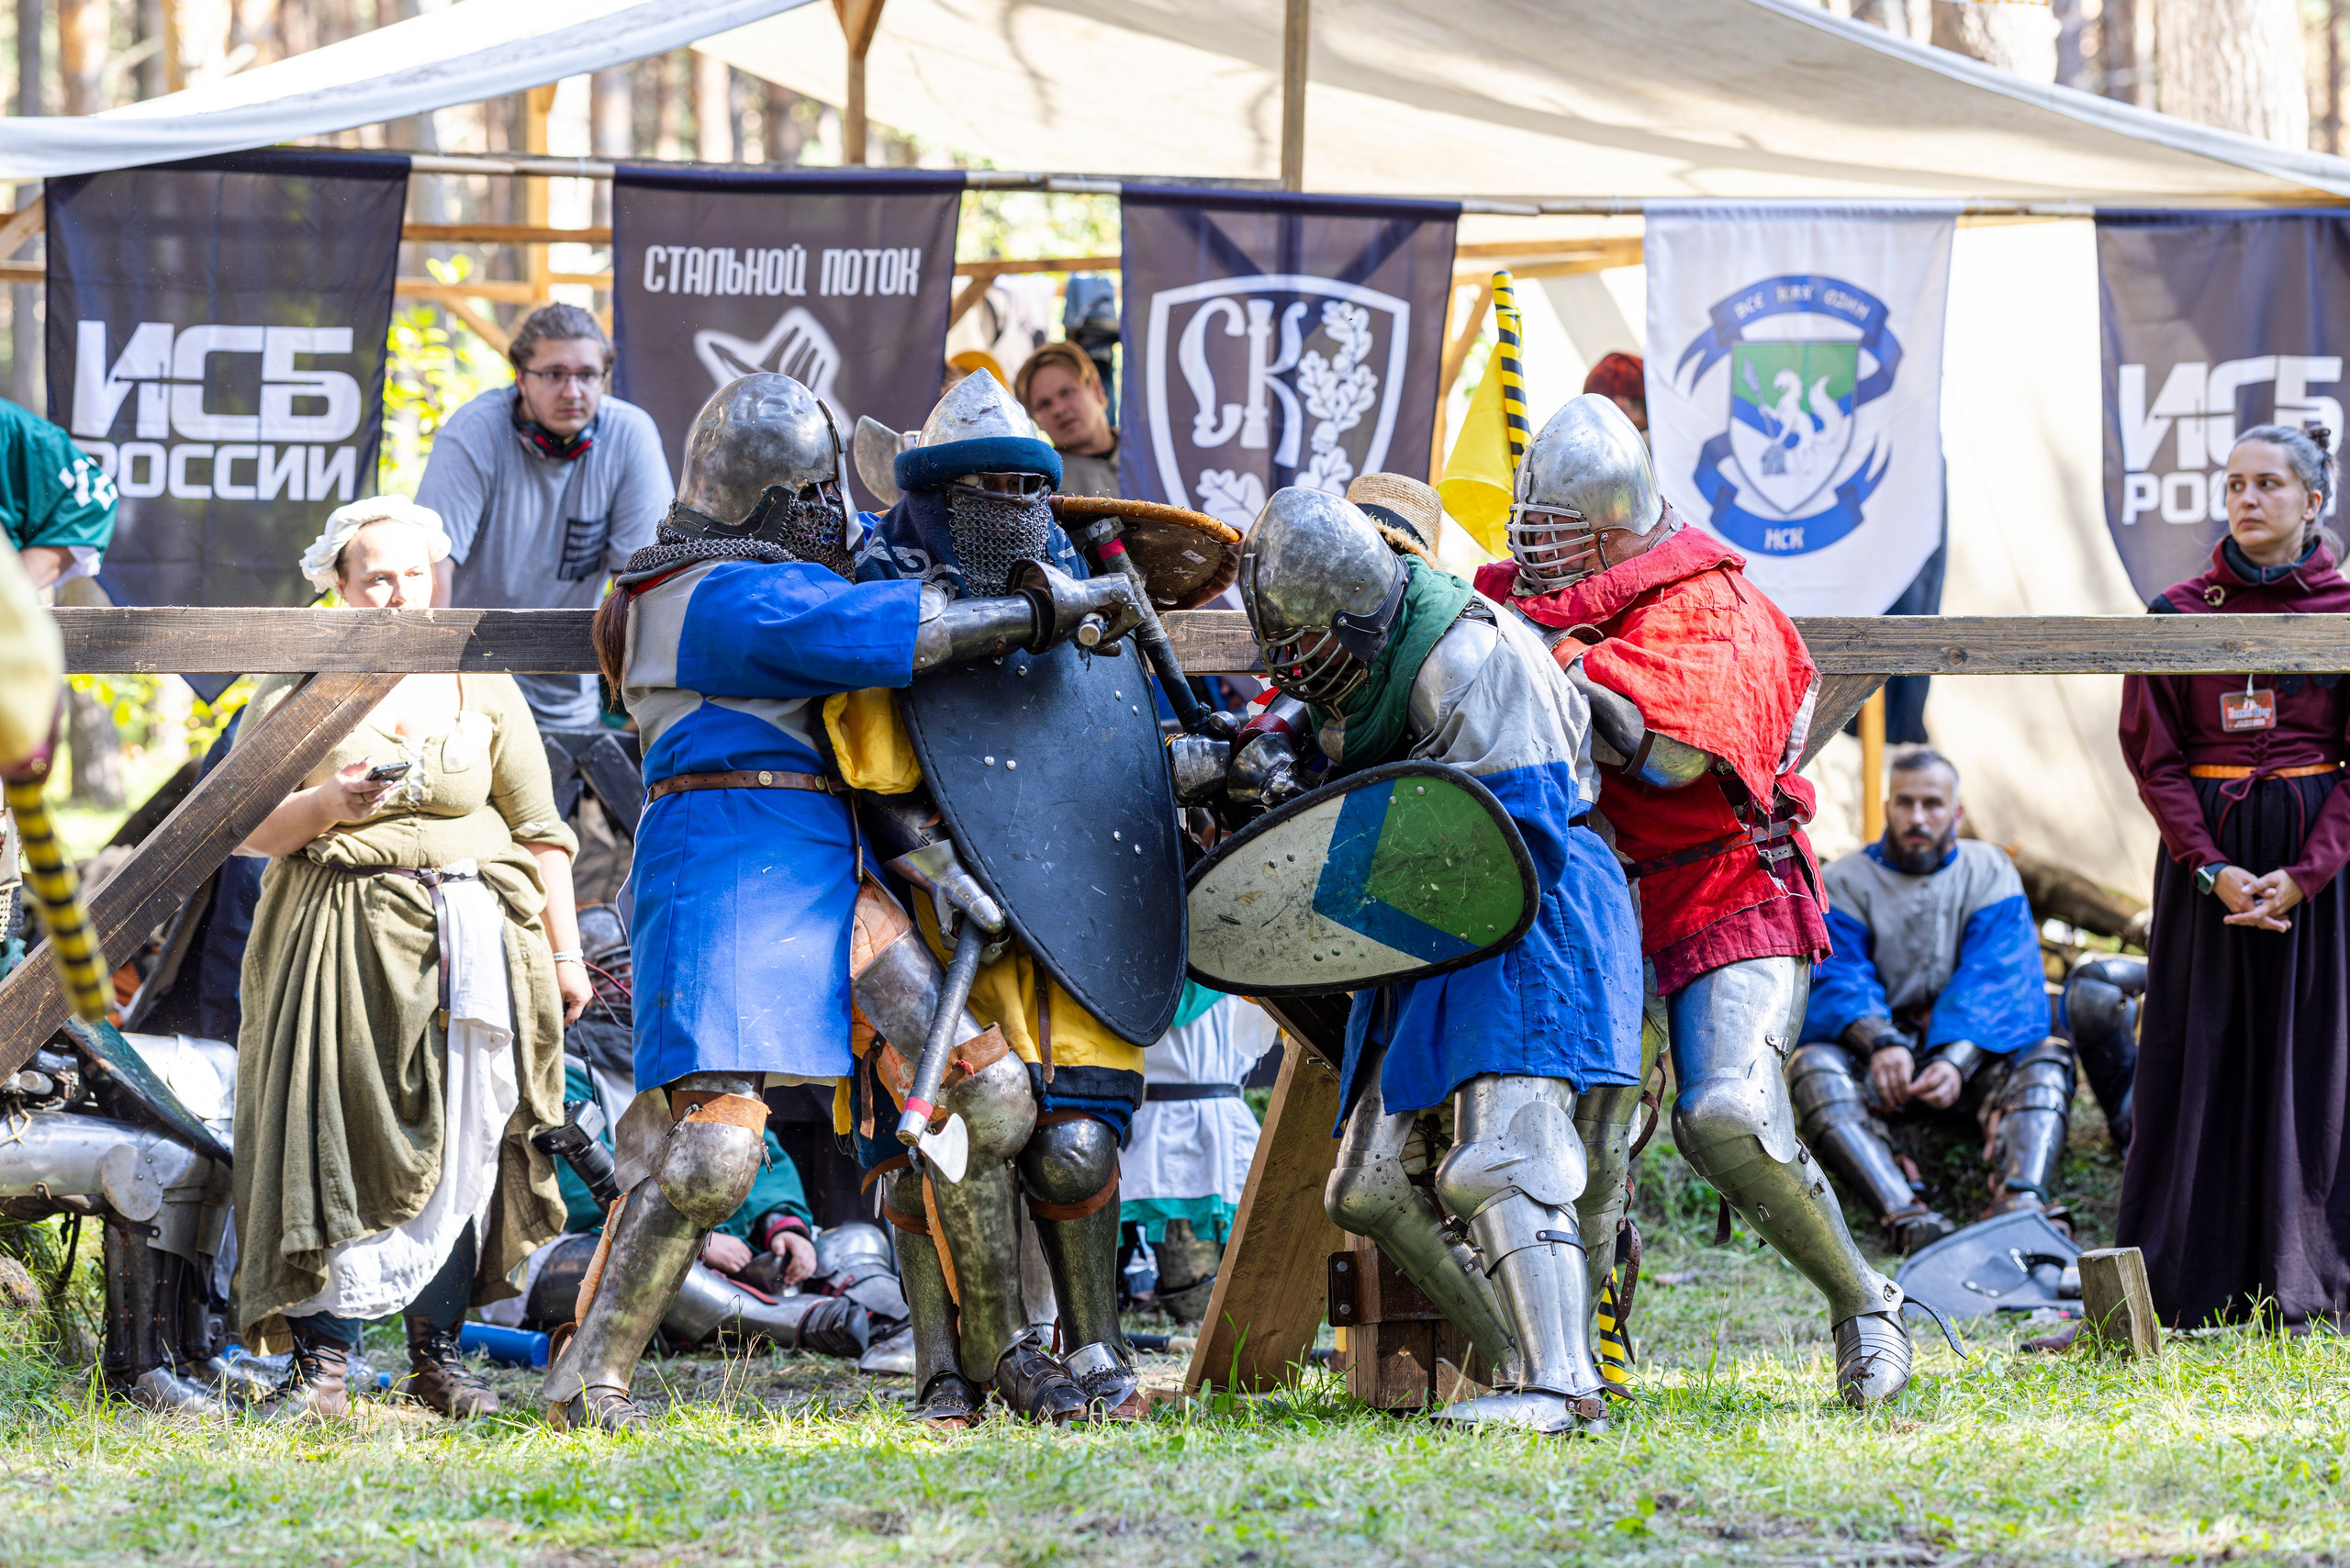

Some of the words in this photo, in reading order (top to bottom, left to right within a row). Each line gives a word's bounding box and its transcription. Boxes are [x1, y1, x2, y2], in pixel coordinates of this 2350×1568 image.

[643, 243, 807, 297] СТАЛЬНОЙ
[820, 247, 922, 297] ПОТОК
[71, 320, 362, 442] ИСБ
